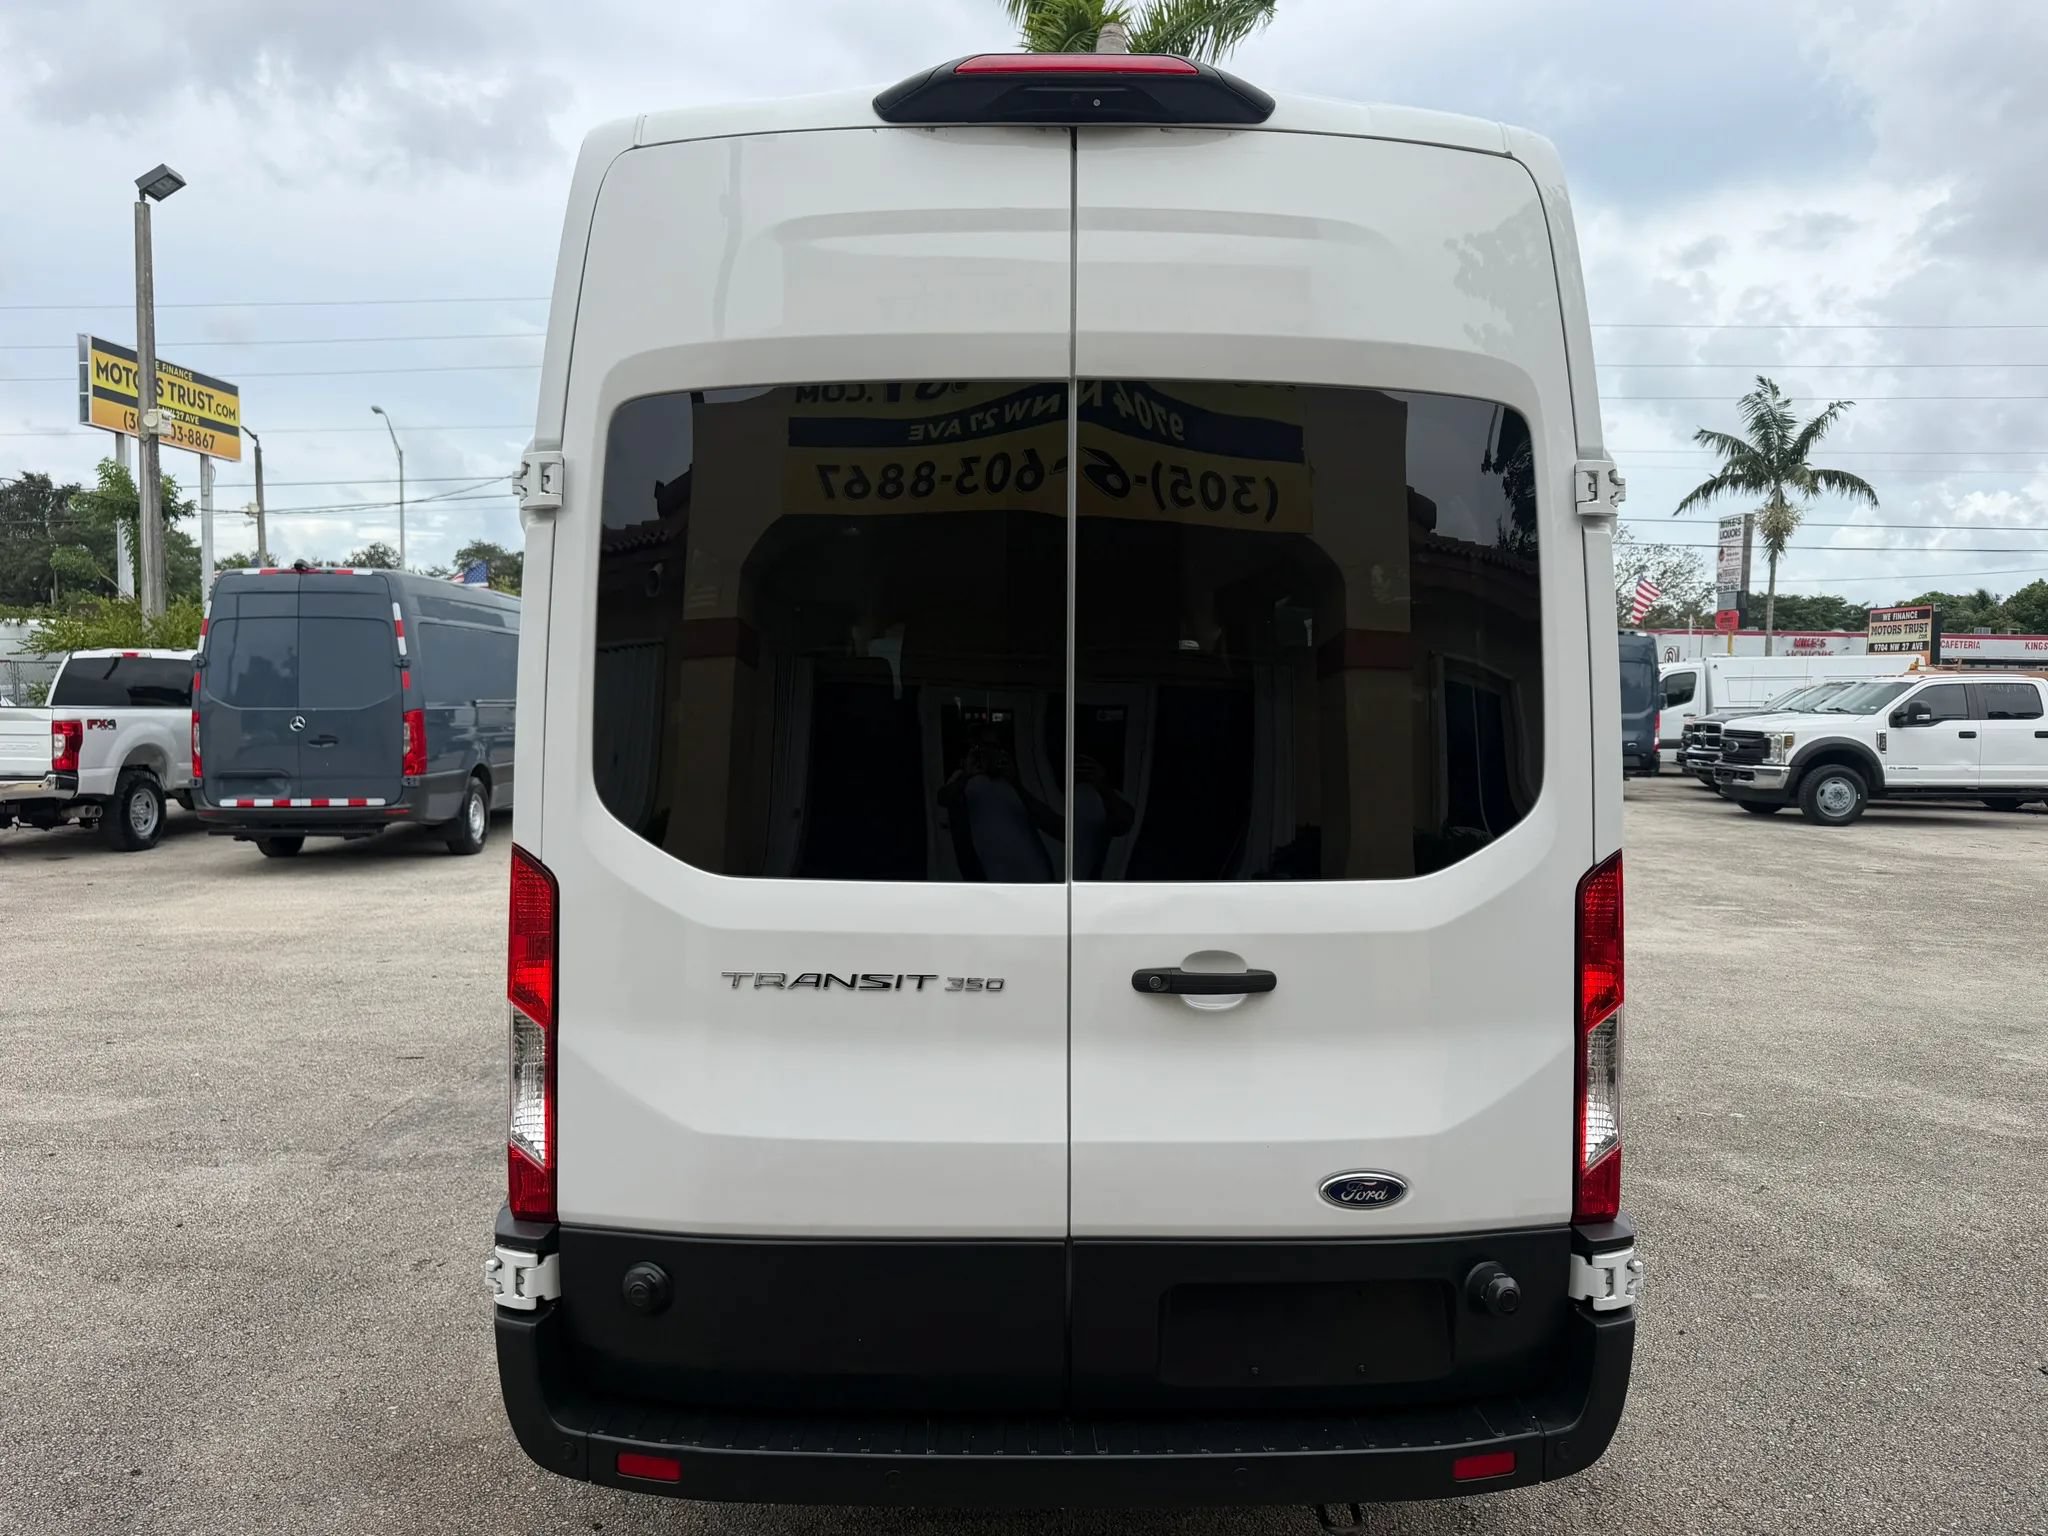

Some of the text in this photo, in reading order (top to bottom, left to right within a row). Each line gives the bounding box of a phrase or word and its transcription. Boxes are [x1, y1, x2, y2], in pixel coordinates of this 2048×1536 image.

[162, 362, 193, 382] FINANCE
[185, 414, 200, 425] AVE
[1882, 611, 1918, 621] WE FINANCE
[1871, 623, 1929, 635] MOTORS TRUST
[1874, 642, 1923, 651] 9704 NW 27 AVE
[1940, 640, 1980, 649] CAFETERIA
[86, 719, 117, 730] FX4
[721, 971, 1005, 992] TRANSIT 350
[1341, 1181, 1389, 1201] Ford
